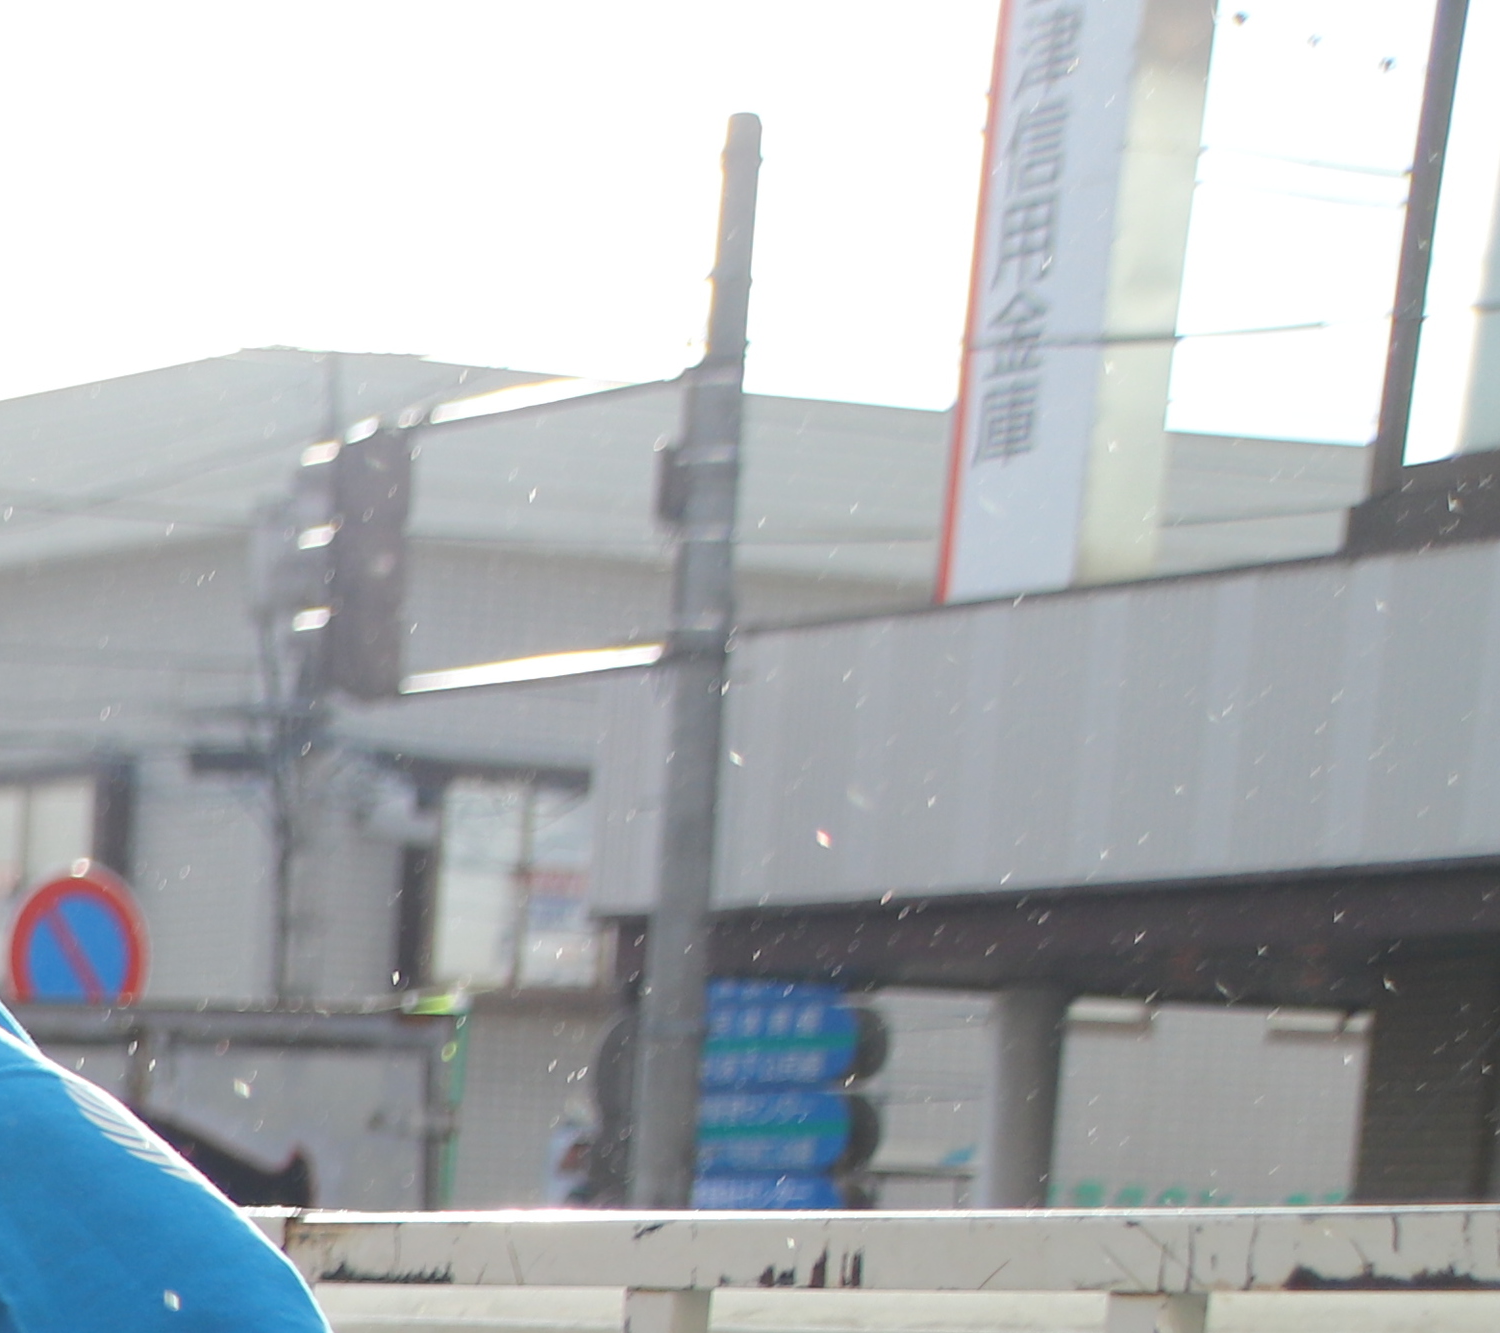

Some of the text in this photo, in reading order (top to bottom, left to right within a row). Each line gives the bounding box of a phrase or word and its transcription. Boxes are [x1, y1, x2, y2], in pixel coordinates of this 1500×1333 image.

[972, 0, 1084, 467] 津信用金庫
